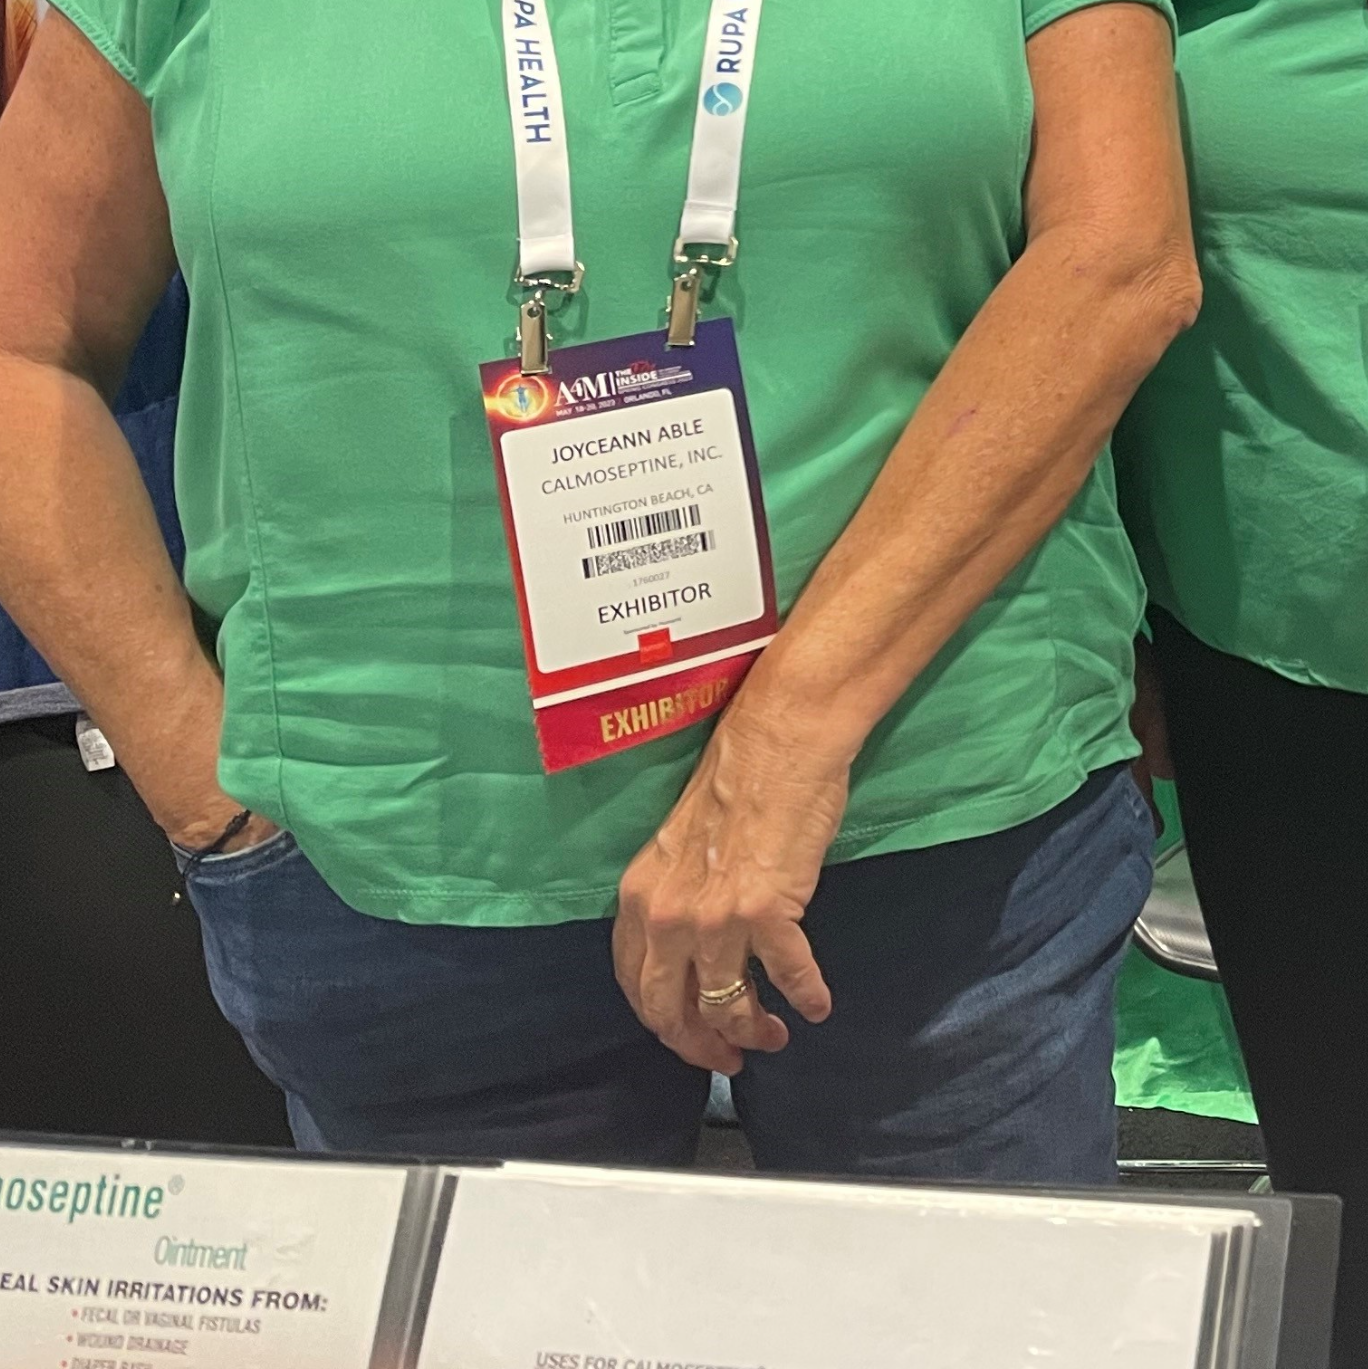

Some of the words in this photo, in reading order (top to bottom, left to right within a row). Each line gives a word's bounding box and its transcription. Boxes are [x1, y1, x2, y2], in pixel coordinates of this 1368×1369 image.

[717, 8, 749, 74] RUPA
[515, 38, 552, 143] HEALTH
[616, 371, 658, 387] INSIDE
[552, 429, 652, 464] JOYCEANN
[657, 418, 704, 443] ABLE
[541, 456, 684, 496] CALMOSEPTINE,
[688, 445, 723, 465] INC.
[563, 497, 648, 524] HUNTINGTON
[650, 488, 695, 507] BEACH,
[696, 482, 714, 497] CA
[598, 582, 712, 624] EXHIBITOR
[0, 1174, 164, 1223] oseptine
[154, 1234, 249, 1271] Ointment
[0, 1272, 38, 1293] EAL
[46, 1276, 101, 1297] SKIN
[107, 1281, 243, 1308] IRRITATIONS
[251, 1289, 328, 1313] FROM:
[199, 1315, 262, 1334] FISTULAS
[536, 1351, 580, 1369] USES
